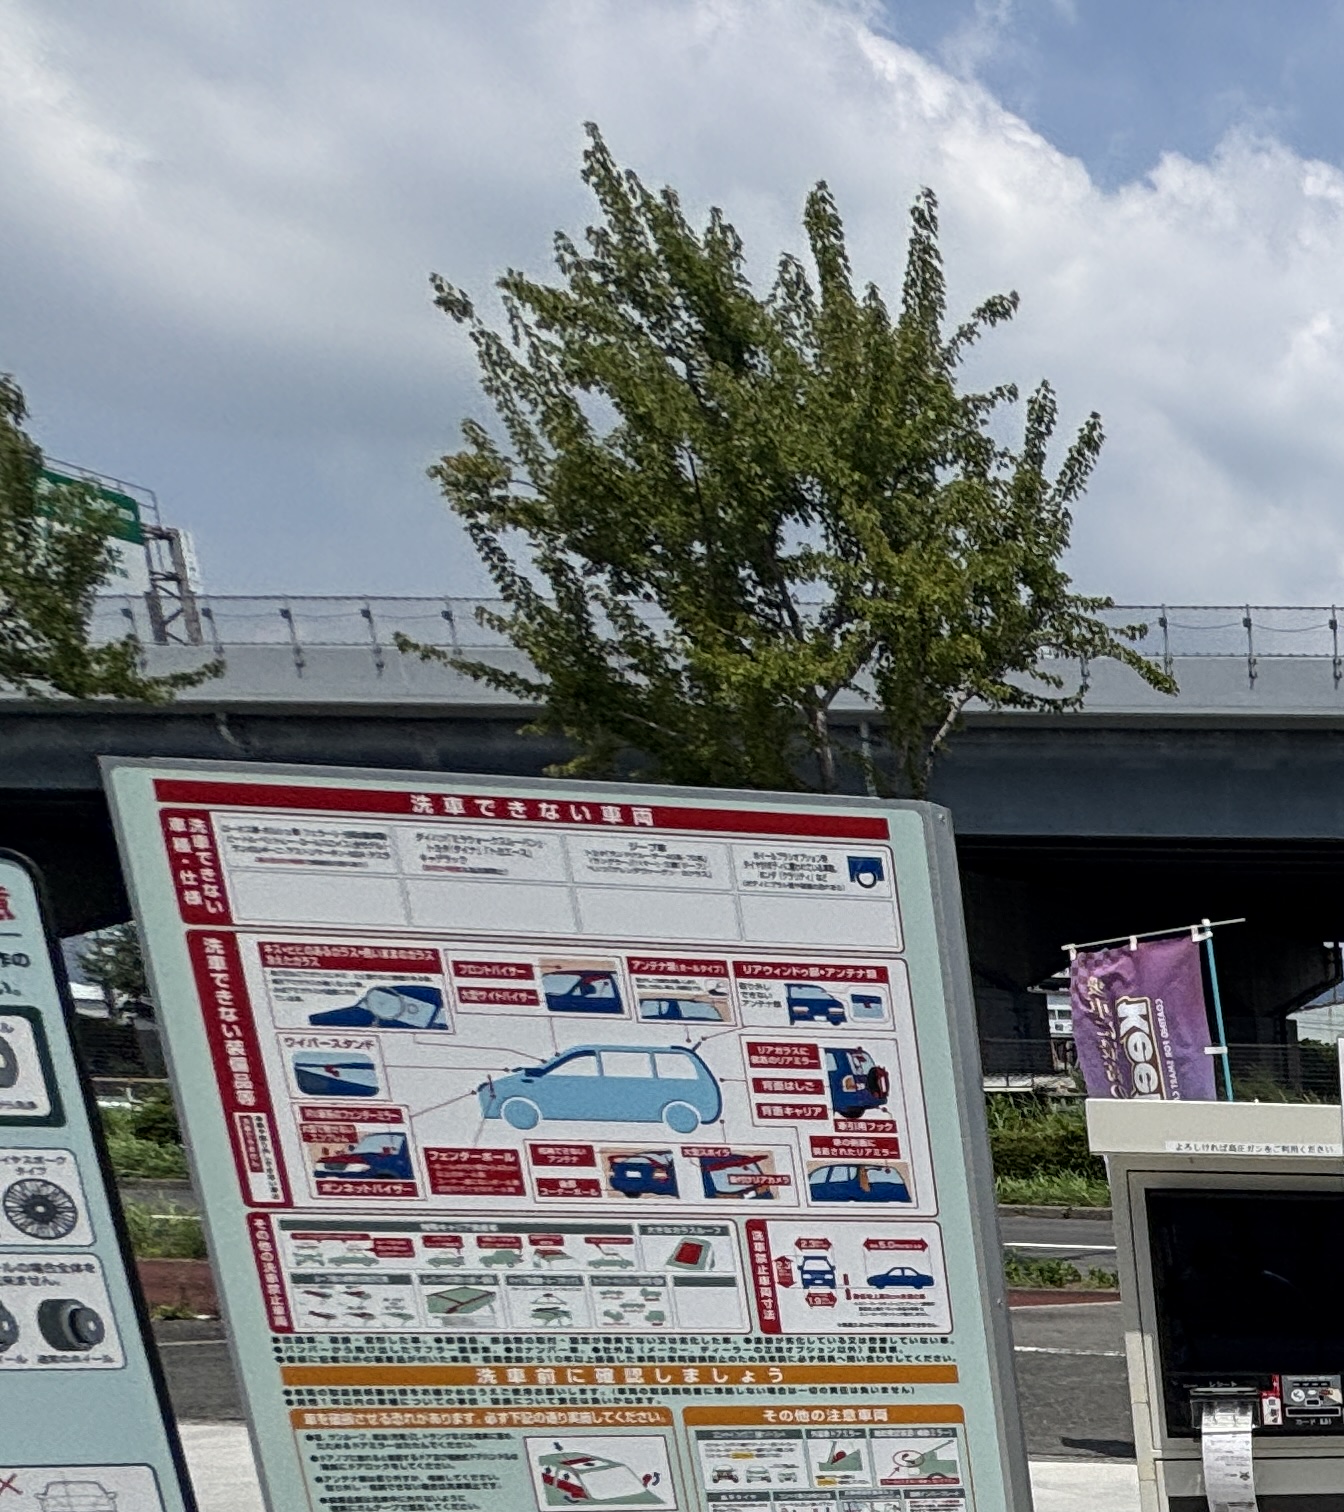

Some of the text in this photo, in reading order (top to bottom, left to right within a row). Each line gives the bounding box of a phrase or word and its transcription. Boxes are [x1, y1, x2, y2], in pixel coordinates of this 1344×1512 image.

[410, 794, 655, 827] 洗車できない車両
[188, 817, 226, 915] 洗車できない
[284, 1036, 375, 1050] ワイパースタンド
[475, 1367, 785, 1385] 洗車前に確認しましょう
[763, 1409, 888, 1423] その他の注意車両
